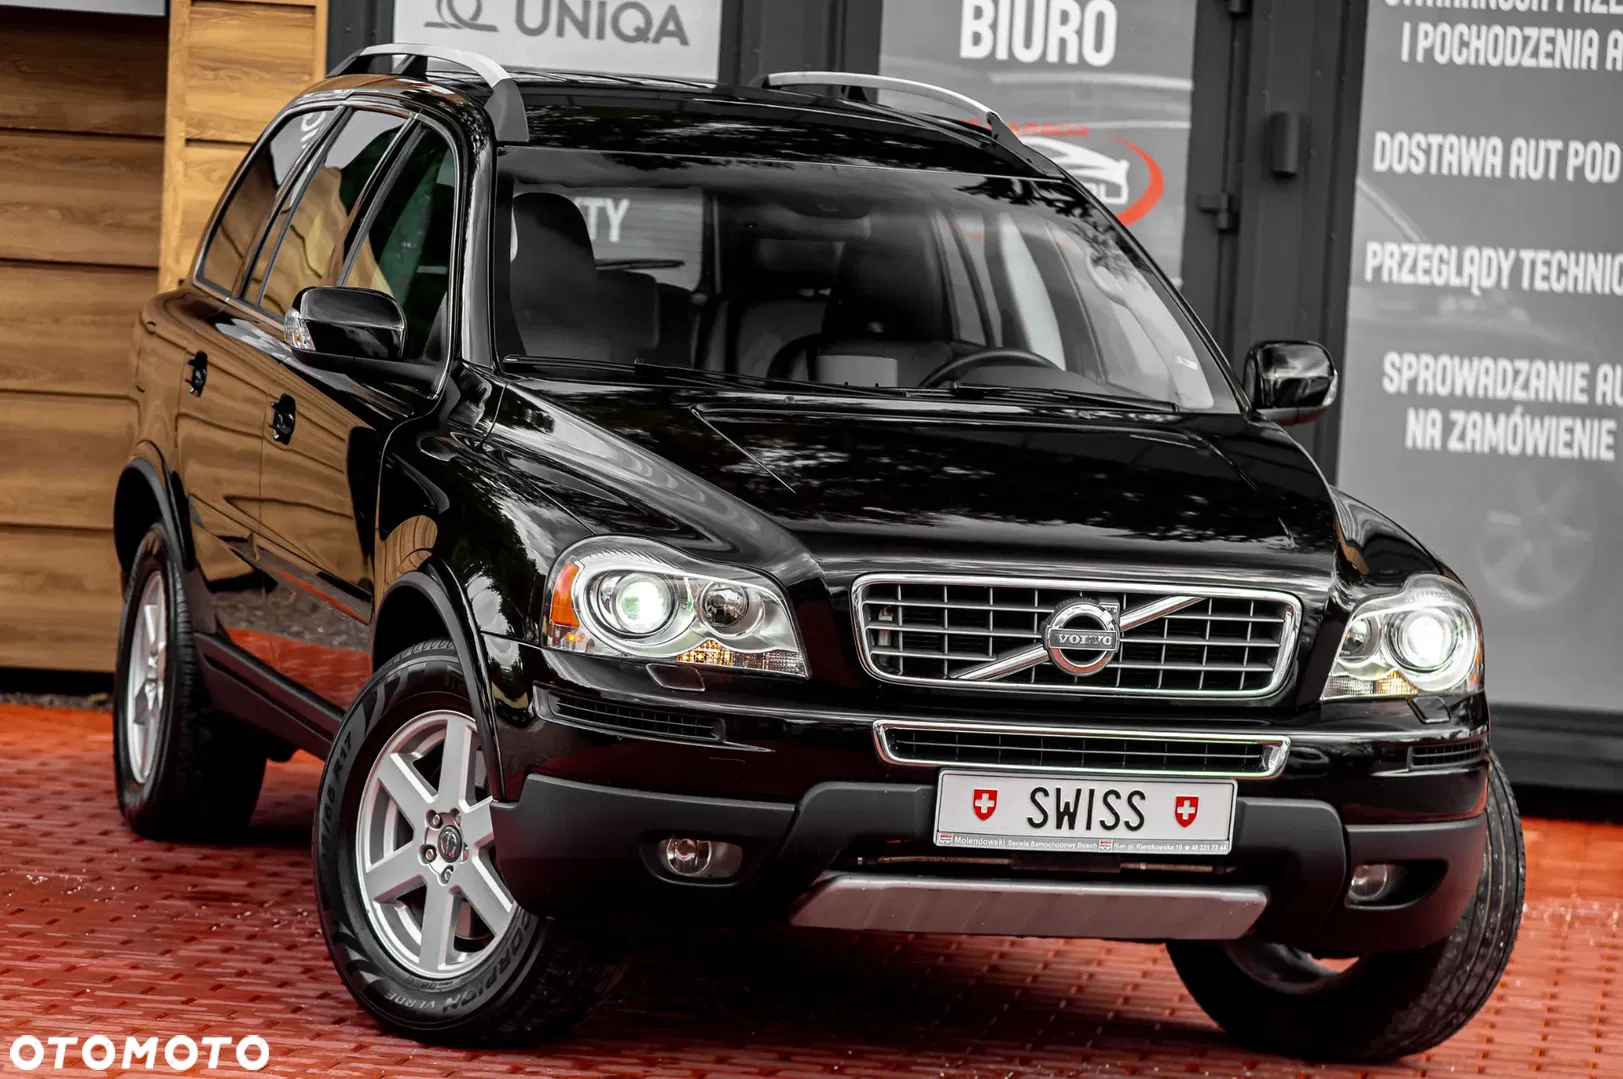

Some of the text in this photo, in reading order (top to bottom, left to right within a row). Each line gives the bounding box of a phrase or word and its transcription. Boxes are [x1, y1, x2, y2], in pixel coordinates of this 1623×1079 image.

[515, 0, 690, 46] UNIQA
[959, 0, 1118, 67] BIURO
[1401, 21, 1411, 62] I
[1416, 21, 1599, 70] POCHODZENIA
[1373, 131, 1622, 184] DOSTAWA AUT POD
[574, 196, 630, 242] TY
[1364, 241, 1516, 296] PRZEGLĄDY
[1382, 351, 1590, 405] SPROWADZANIE
[1405, 405, 1617, 461] NA ZAMÓWIENIE
[1057, 634, 1113, 646] VOLVO
[1027, 786, 1146, 831] SWISS
[954, 835, 1006, 846] Molendowski
[1030, 840, 1076, 849] Samochodowy
[1077, 842, 1098, 850] Bosch
[385, 911, 532, 1013] CORPION VERDE
